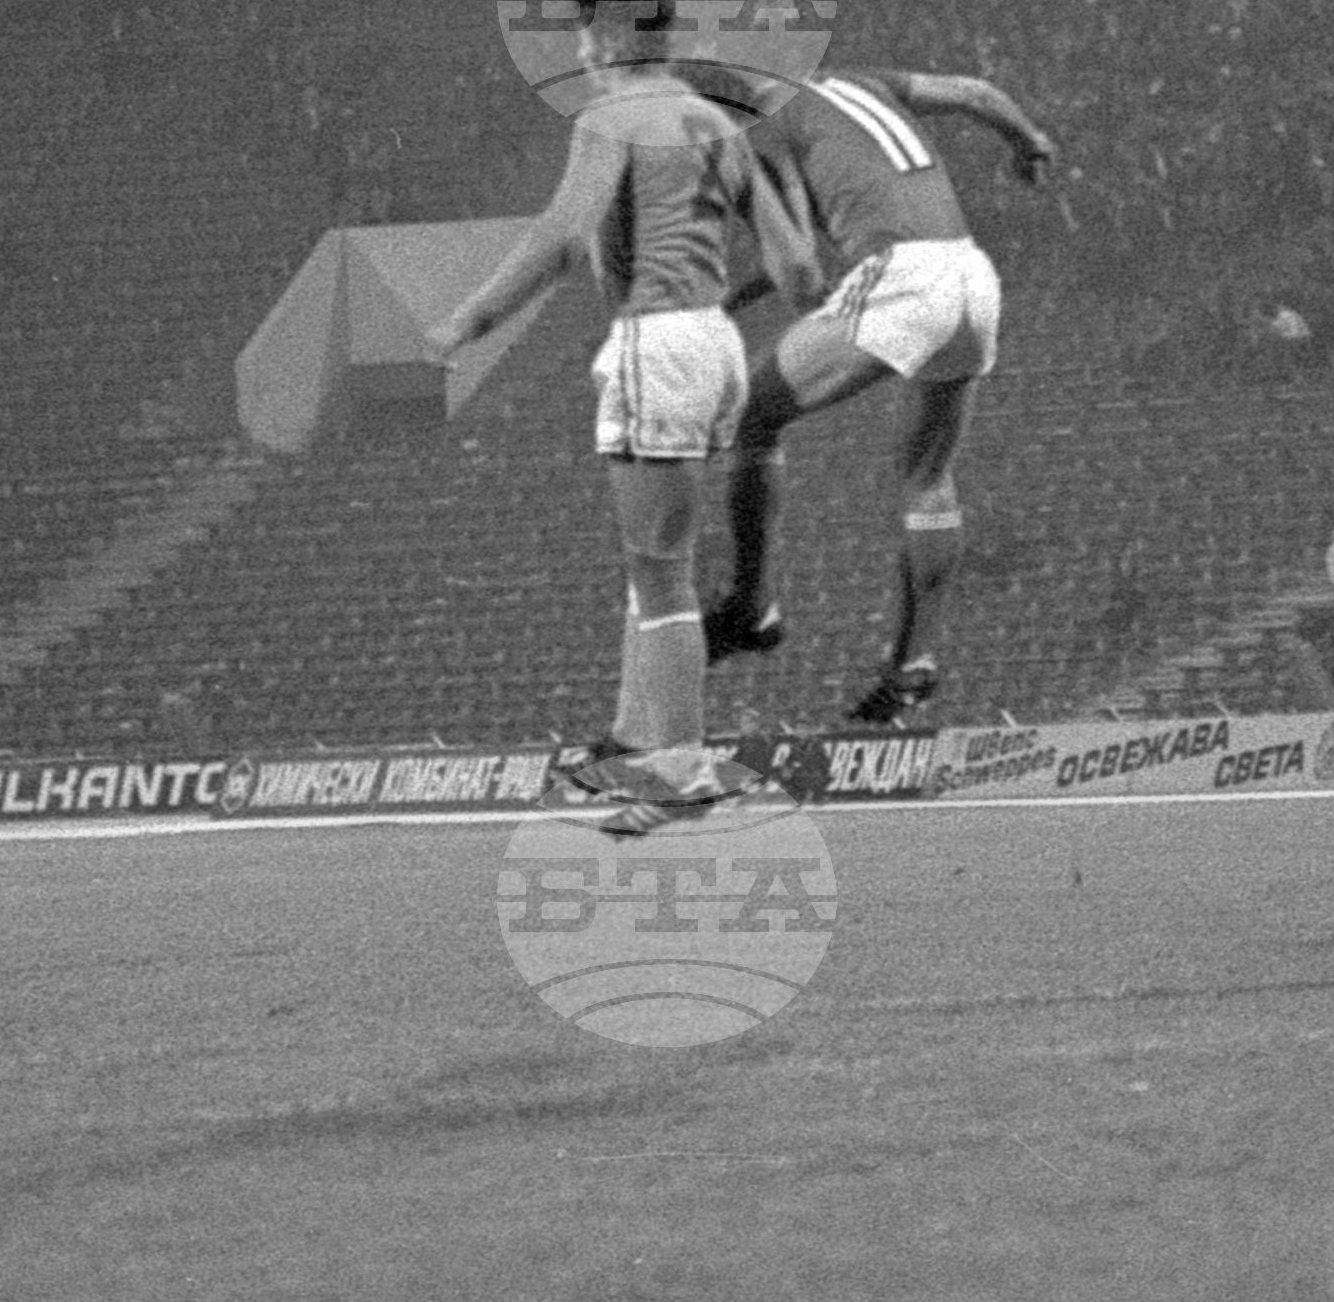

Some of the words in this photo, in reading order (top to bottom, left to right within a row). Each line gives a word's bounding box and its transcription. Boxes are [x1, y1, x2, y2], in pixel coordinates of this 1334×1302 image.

[806, 76, 935, 172] 11
[1056, 719, 1230, 788] ОСВЕЖАВА
[1214, 740, 1305, 788] СВЕТА
